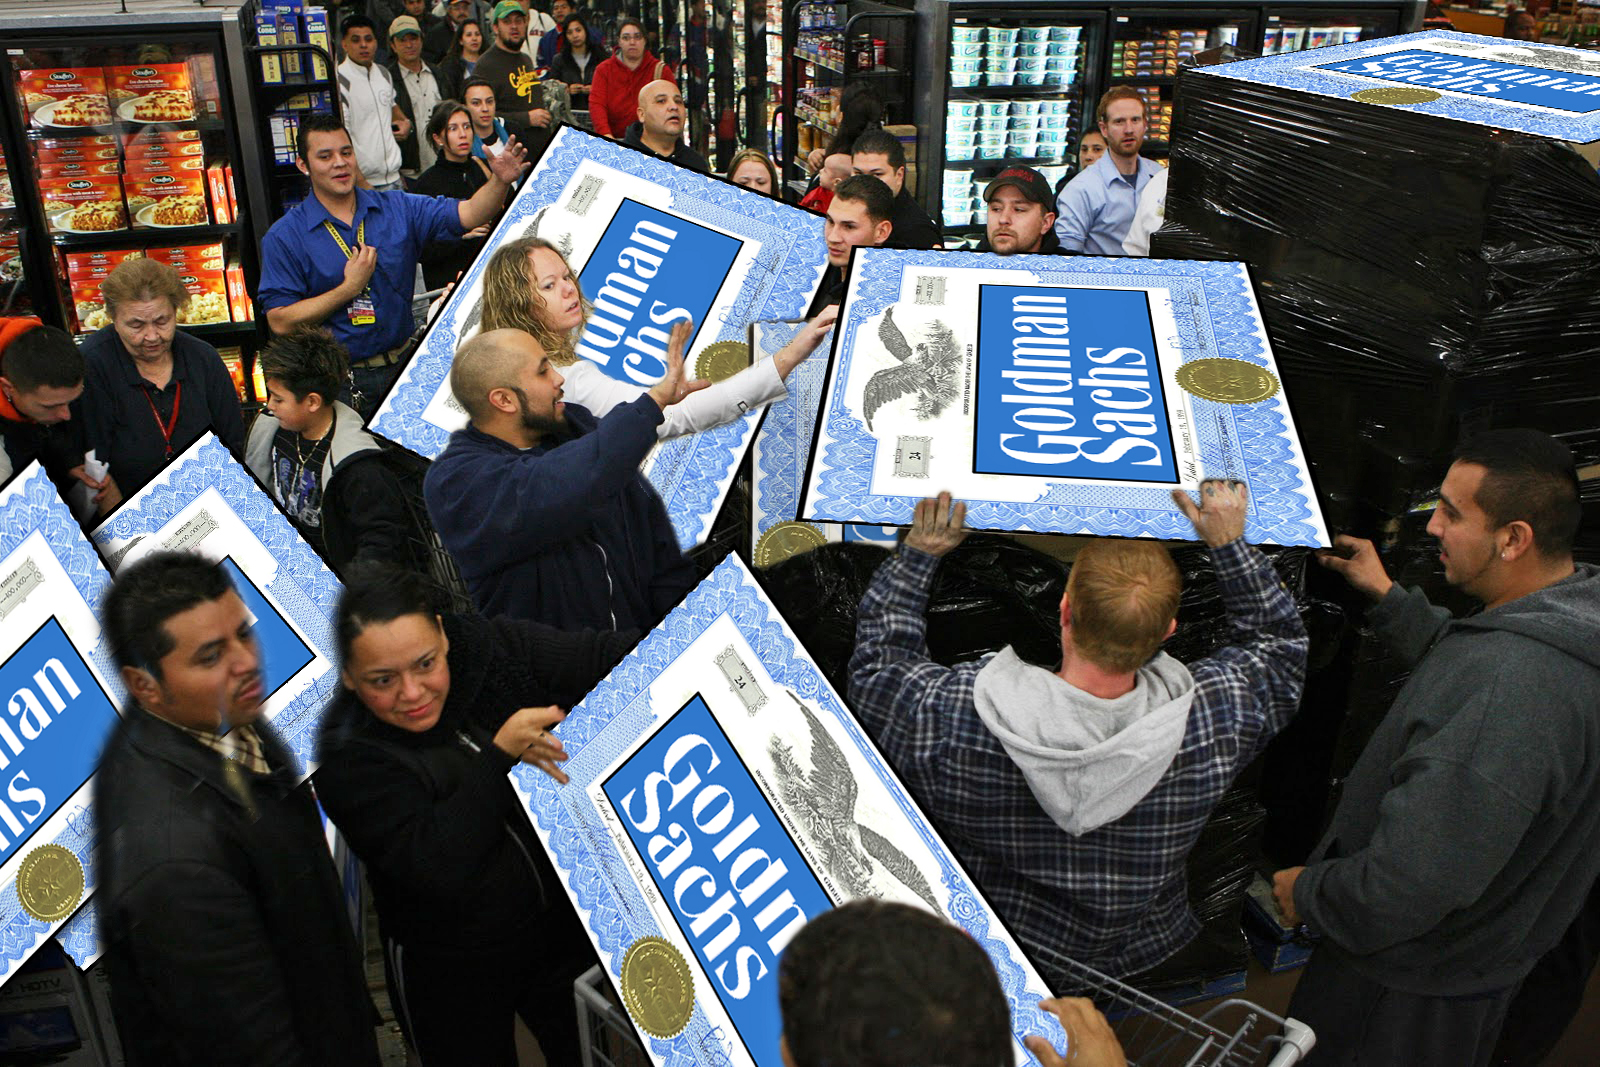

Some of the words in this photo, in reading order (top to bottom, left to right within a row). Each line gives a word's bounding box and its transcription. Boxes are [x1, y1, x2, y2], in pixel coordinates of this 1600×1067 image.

[1335, 61, 1516, 93] Sachs
[623, 300, 693, 387] chs
[1000, 295, 1102, 464] Goldman
[1078, 347, 1162, 466] Sachs
[733, 674, 748, 690] 24
[754, 768, 785, 814] INCORPORATED
[782, 813, 799, 835] UNDER
[796, 834, 807, 848] THE
[803, 847, 819, 866] LAWS
[815, 865, 825, 876] OF
[620, 771, 768, 999] Sachs
[20, 978, 61, 992] HDTV
